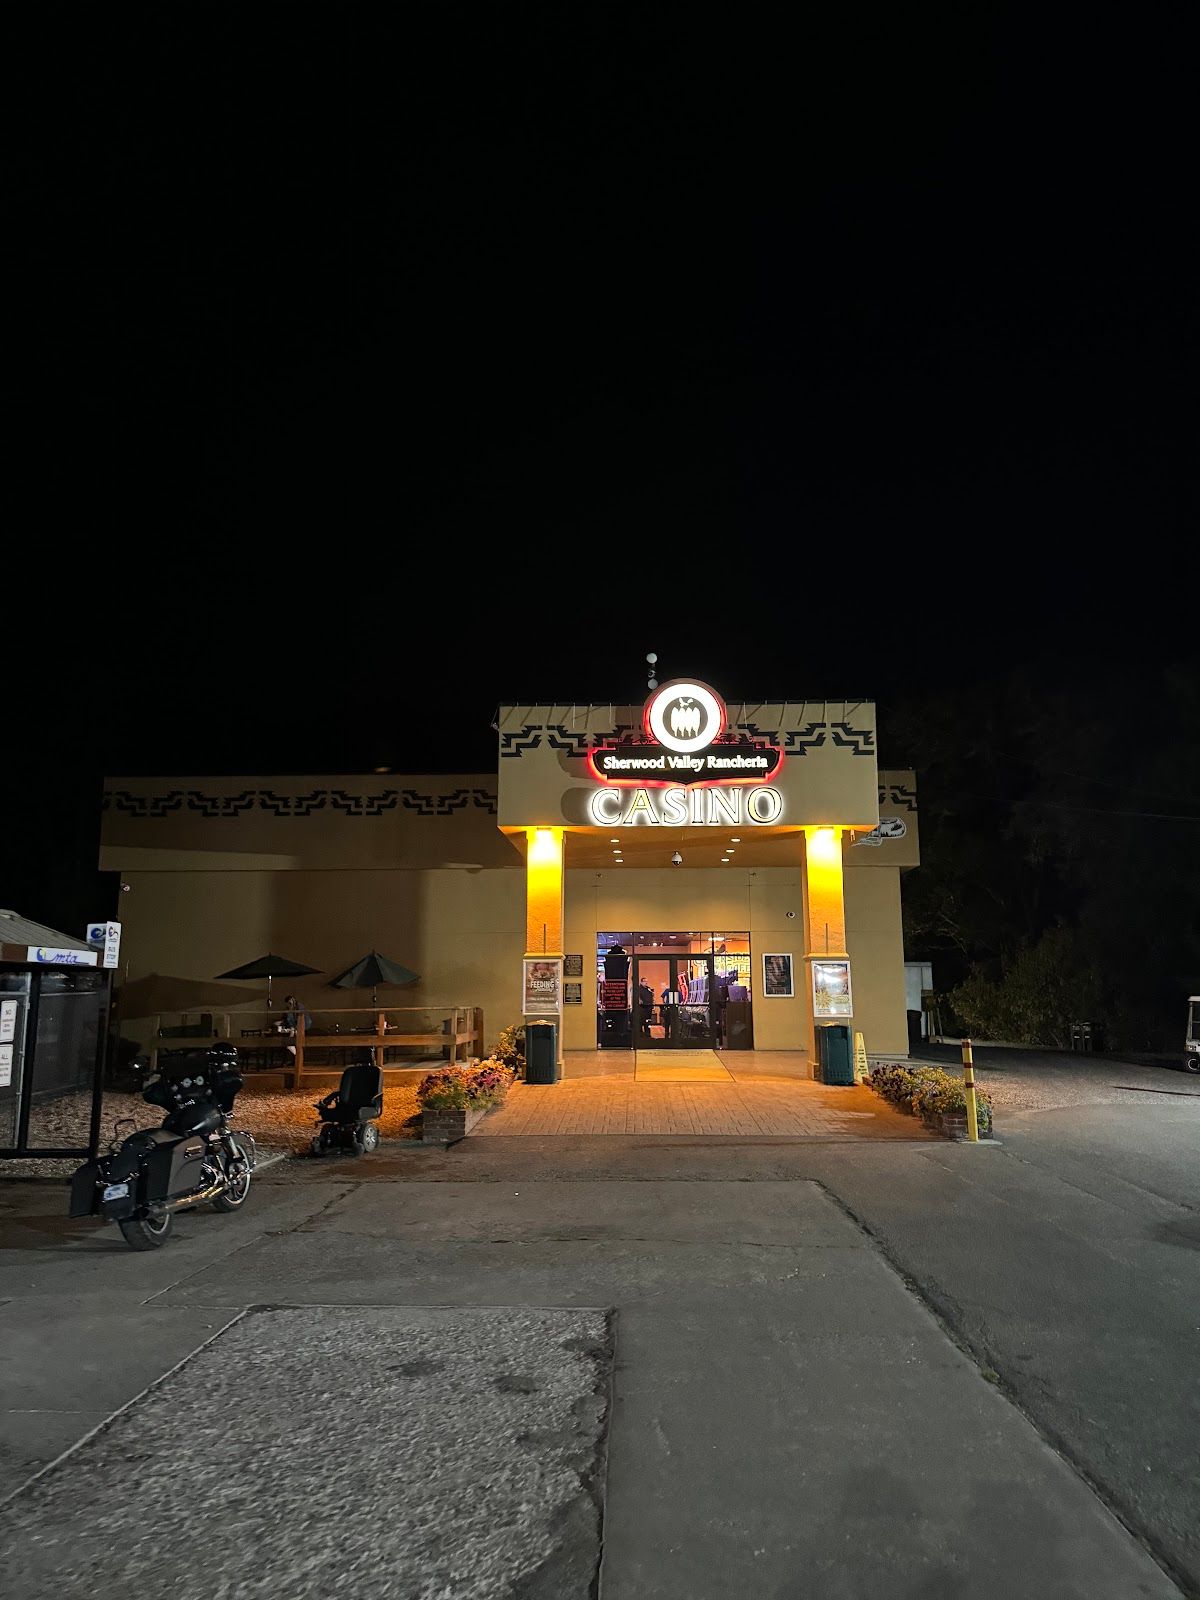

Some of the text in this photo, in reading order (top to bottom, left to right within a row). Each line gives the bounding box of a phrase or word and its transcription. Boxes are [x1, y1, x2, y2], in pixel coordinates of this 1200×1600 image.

[603, 755, 768, 772] Sherwood Valley Rancheria
[591, 787, 782, 824] CASINO
[530, 980, 555, 989] FEEDING
